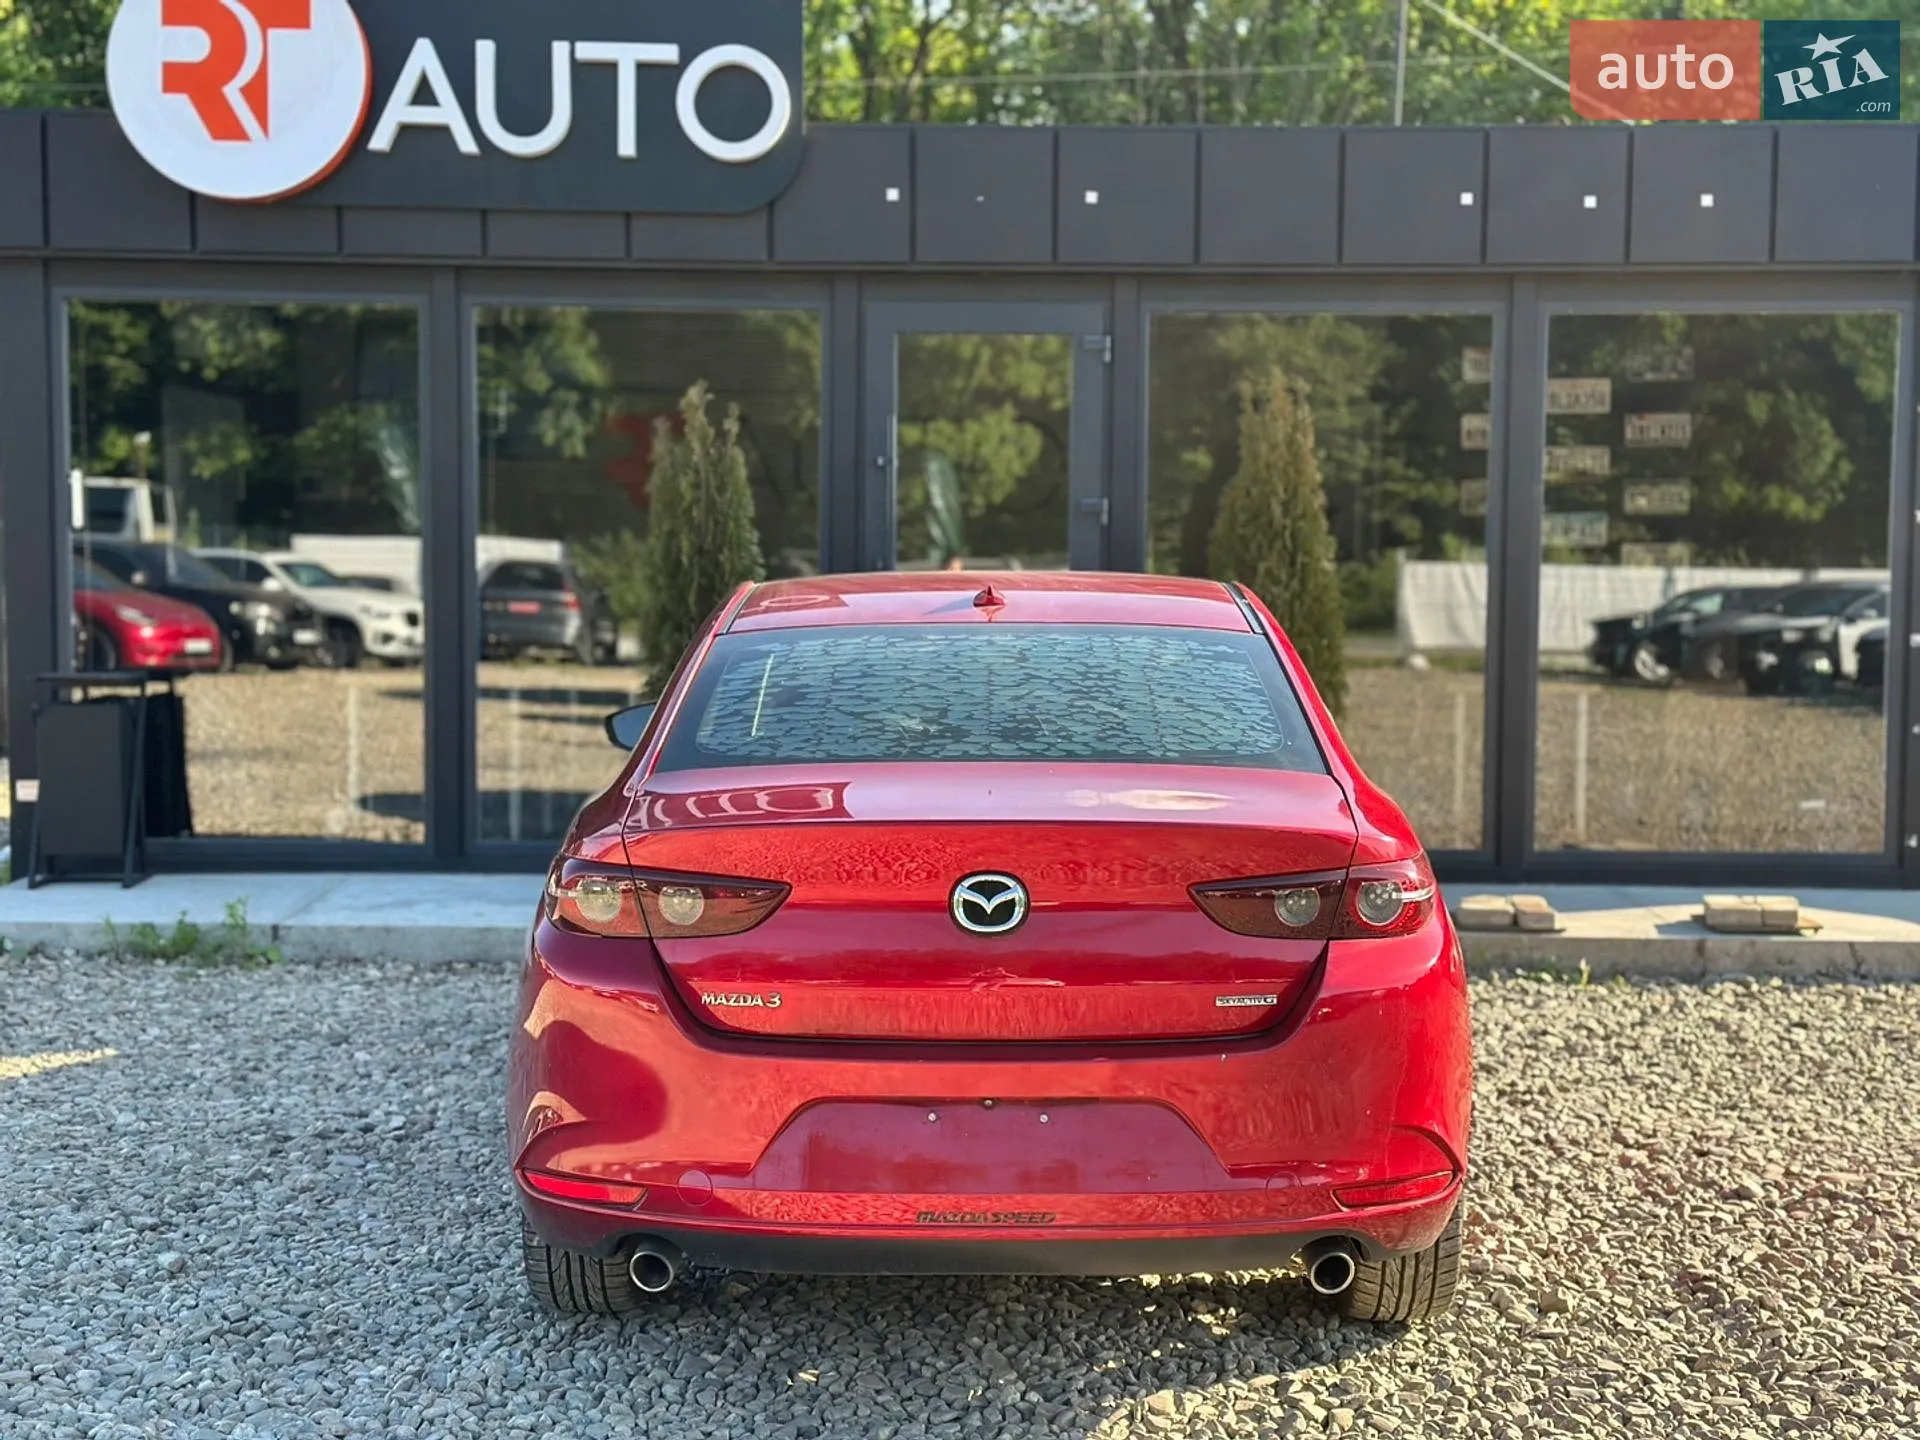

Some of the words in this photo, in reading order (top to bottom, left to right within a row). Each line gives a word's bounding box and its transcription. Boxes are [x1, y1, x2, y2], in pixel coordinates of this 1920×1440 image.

[367, 37, 792, 162] AUTO
[701, 991, 765, 1007] MAZDA
[766, 992, 782, 1008] 3
